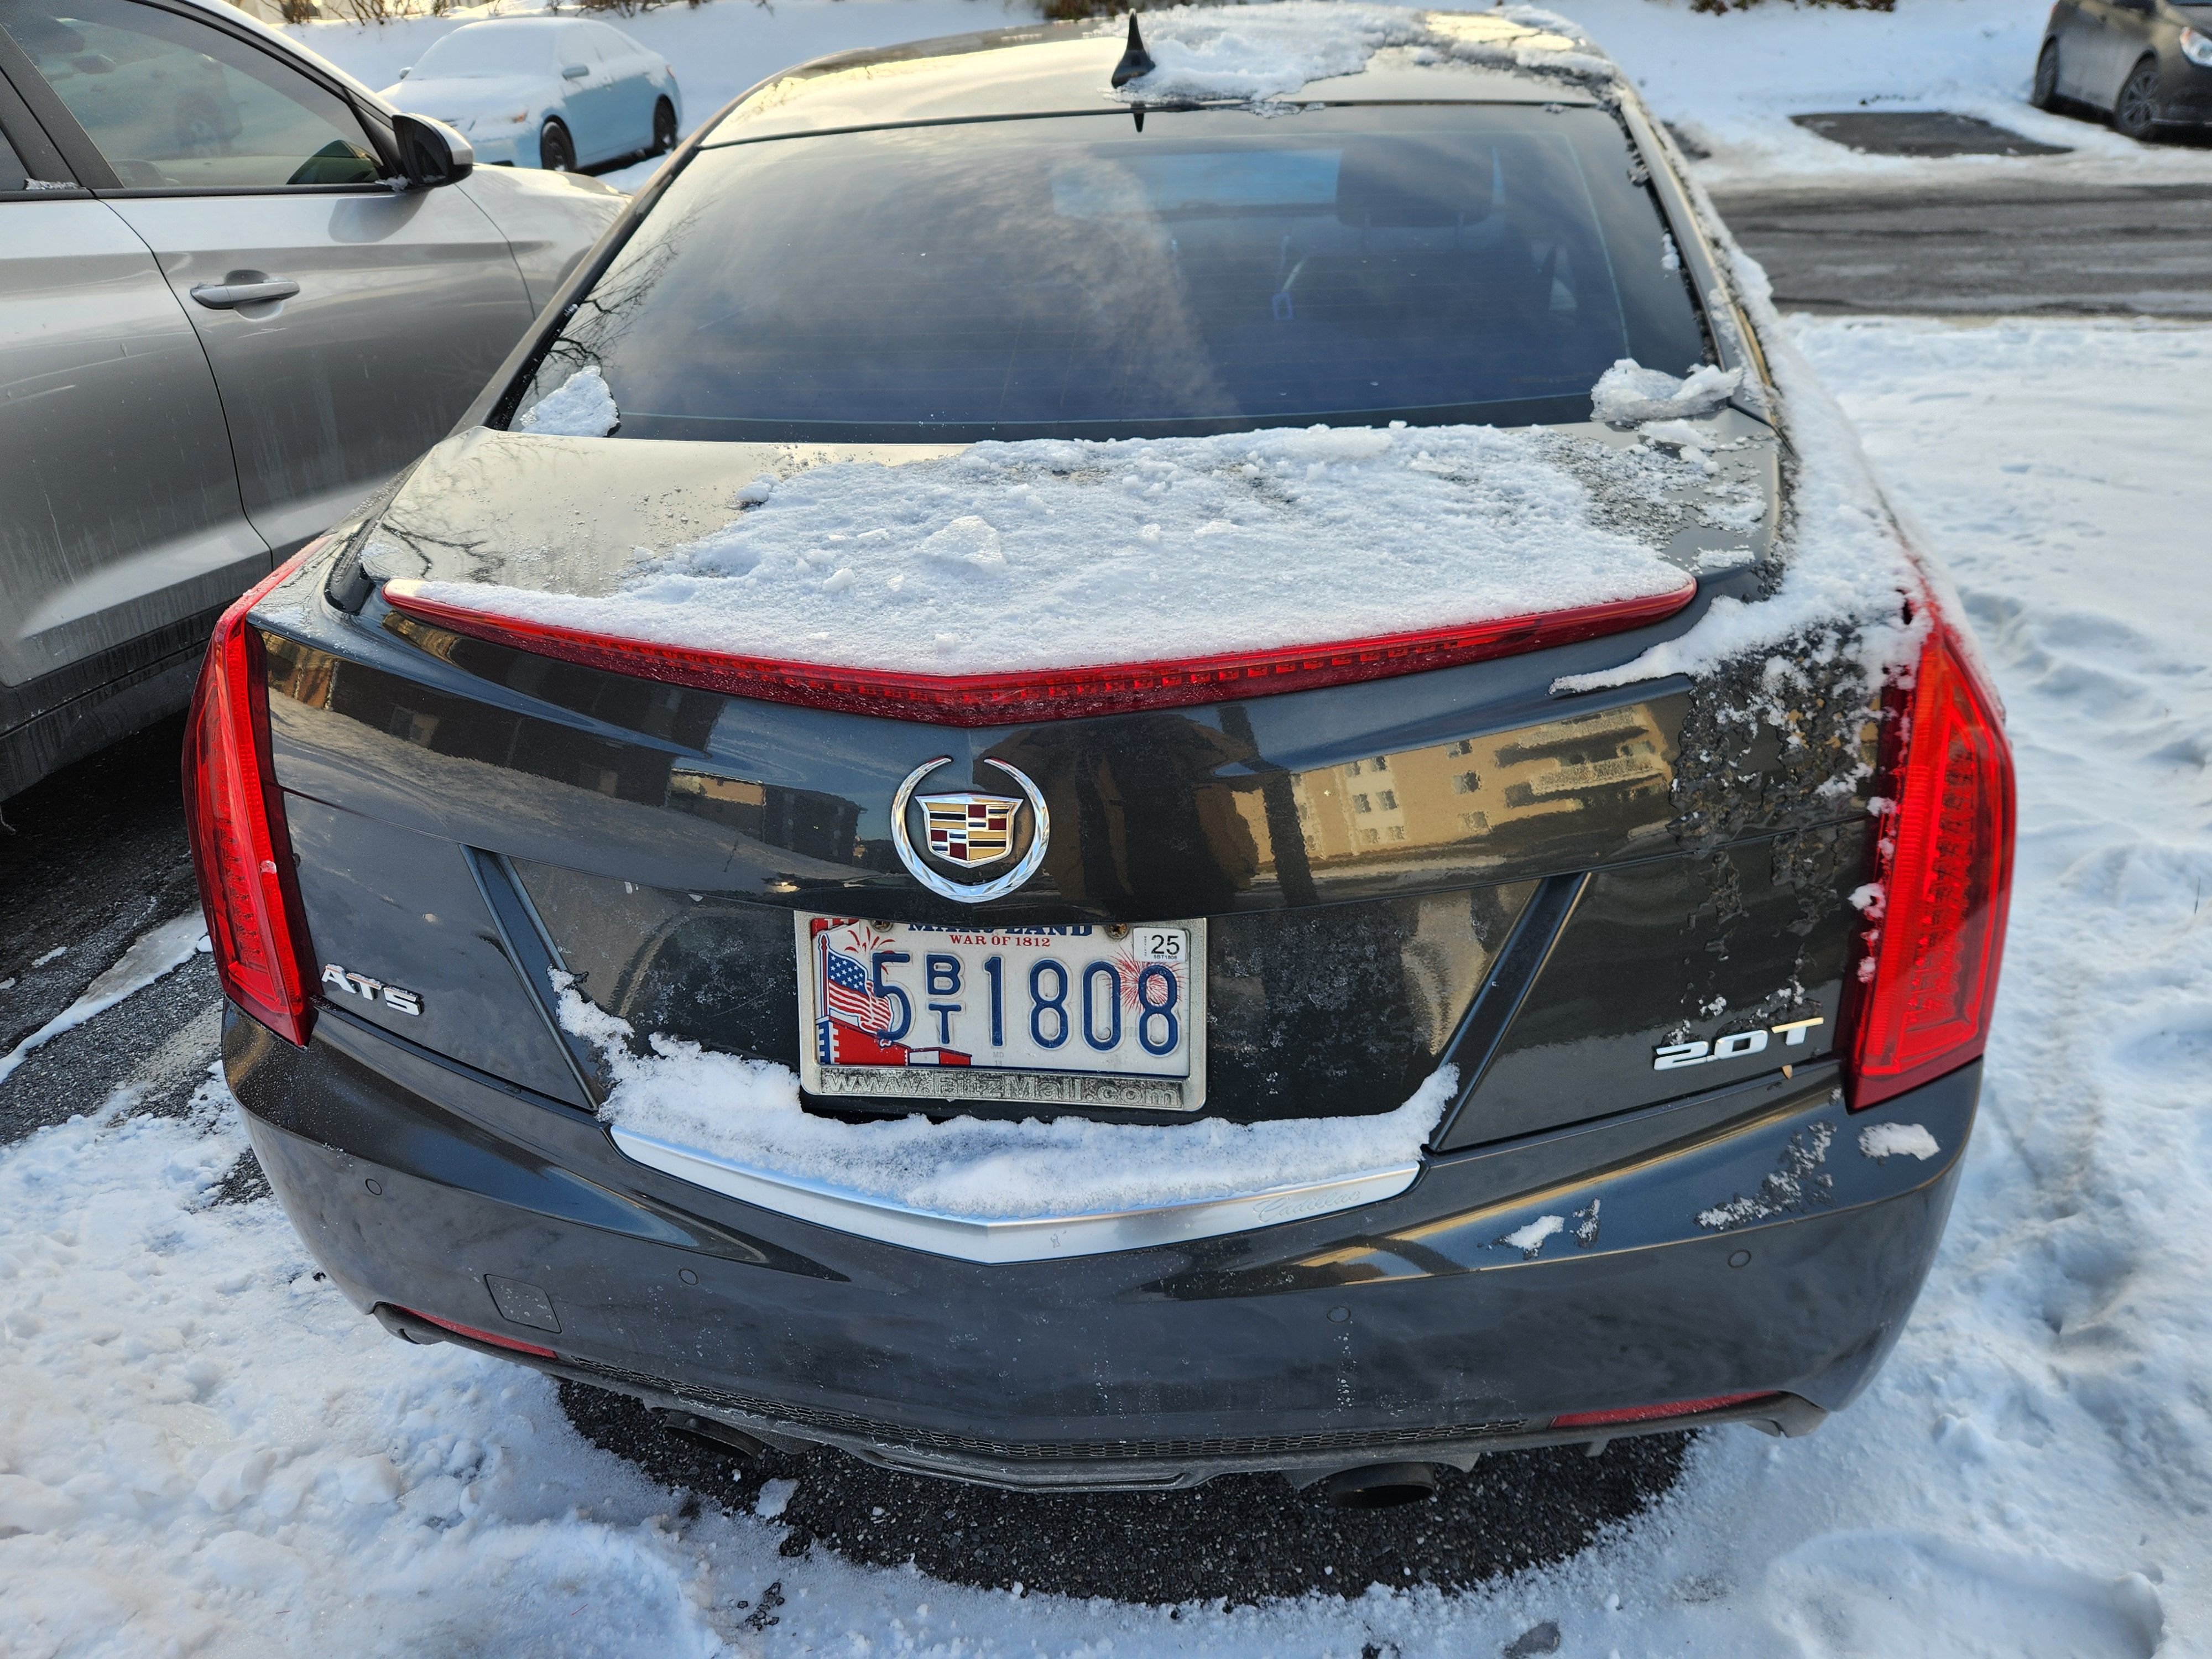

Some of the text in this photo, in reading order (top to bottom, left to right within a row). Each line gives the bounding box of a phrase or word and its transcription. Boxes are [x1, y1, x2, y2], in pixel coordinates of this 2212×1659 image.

[950, 934, 1051, 947] WAR OF 1812
[1151, 935, 1180, 955] 25
[321, 964, 422, 1016] ATS
[829, 1073, 1179, 1105] www.FitzMall.com
[1253, 1190, 1360, 1223] Cadillac
